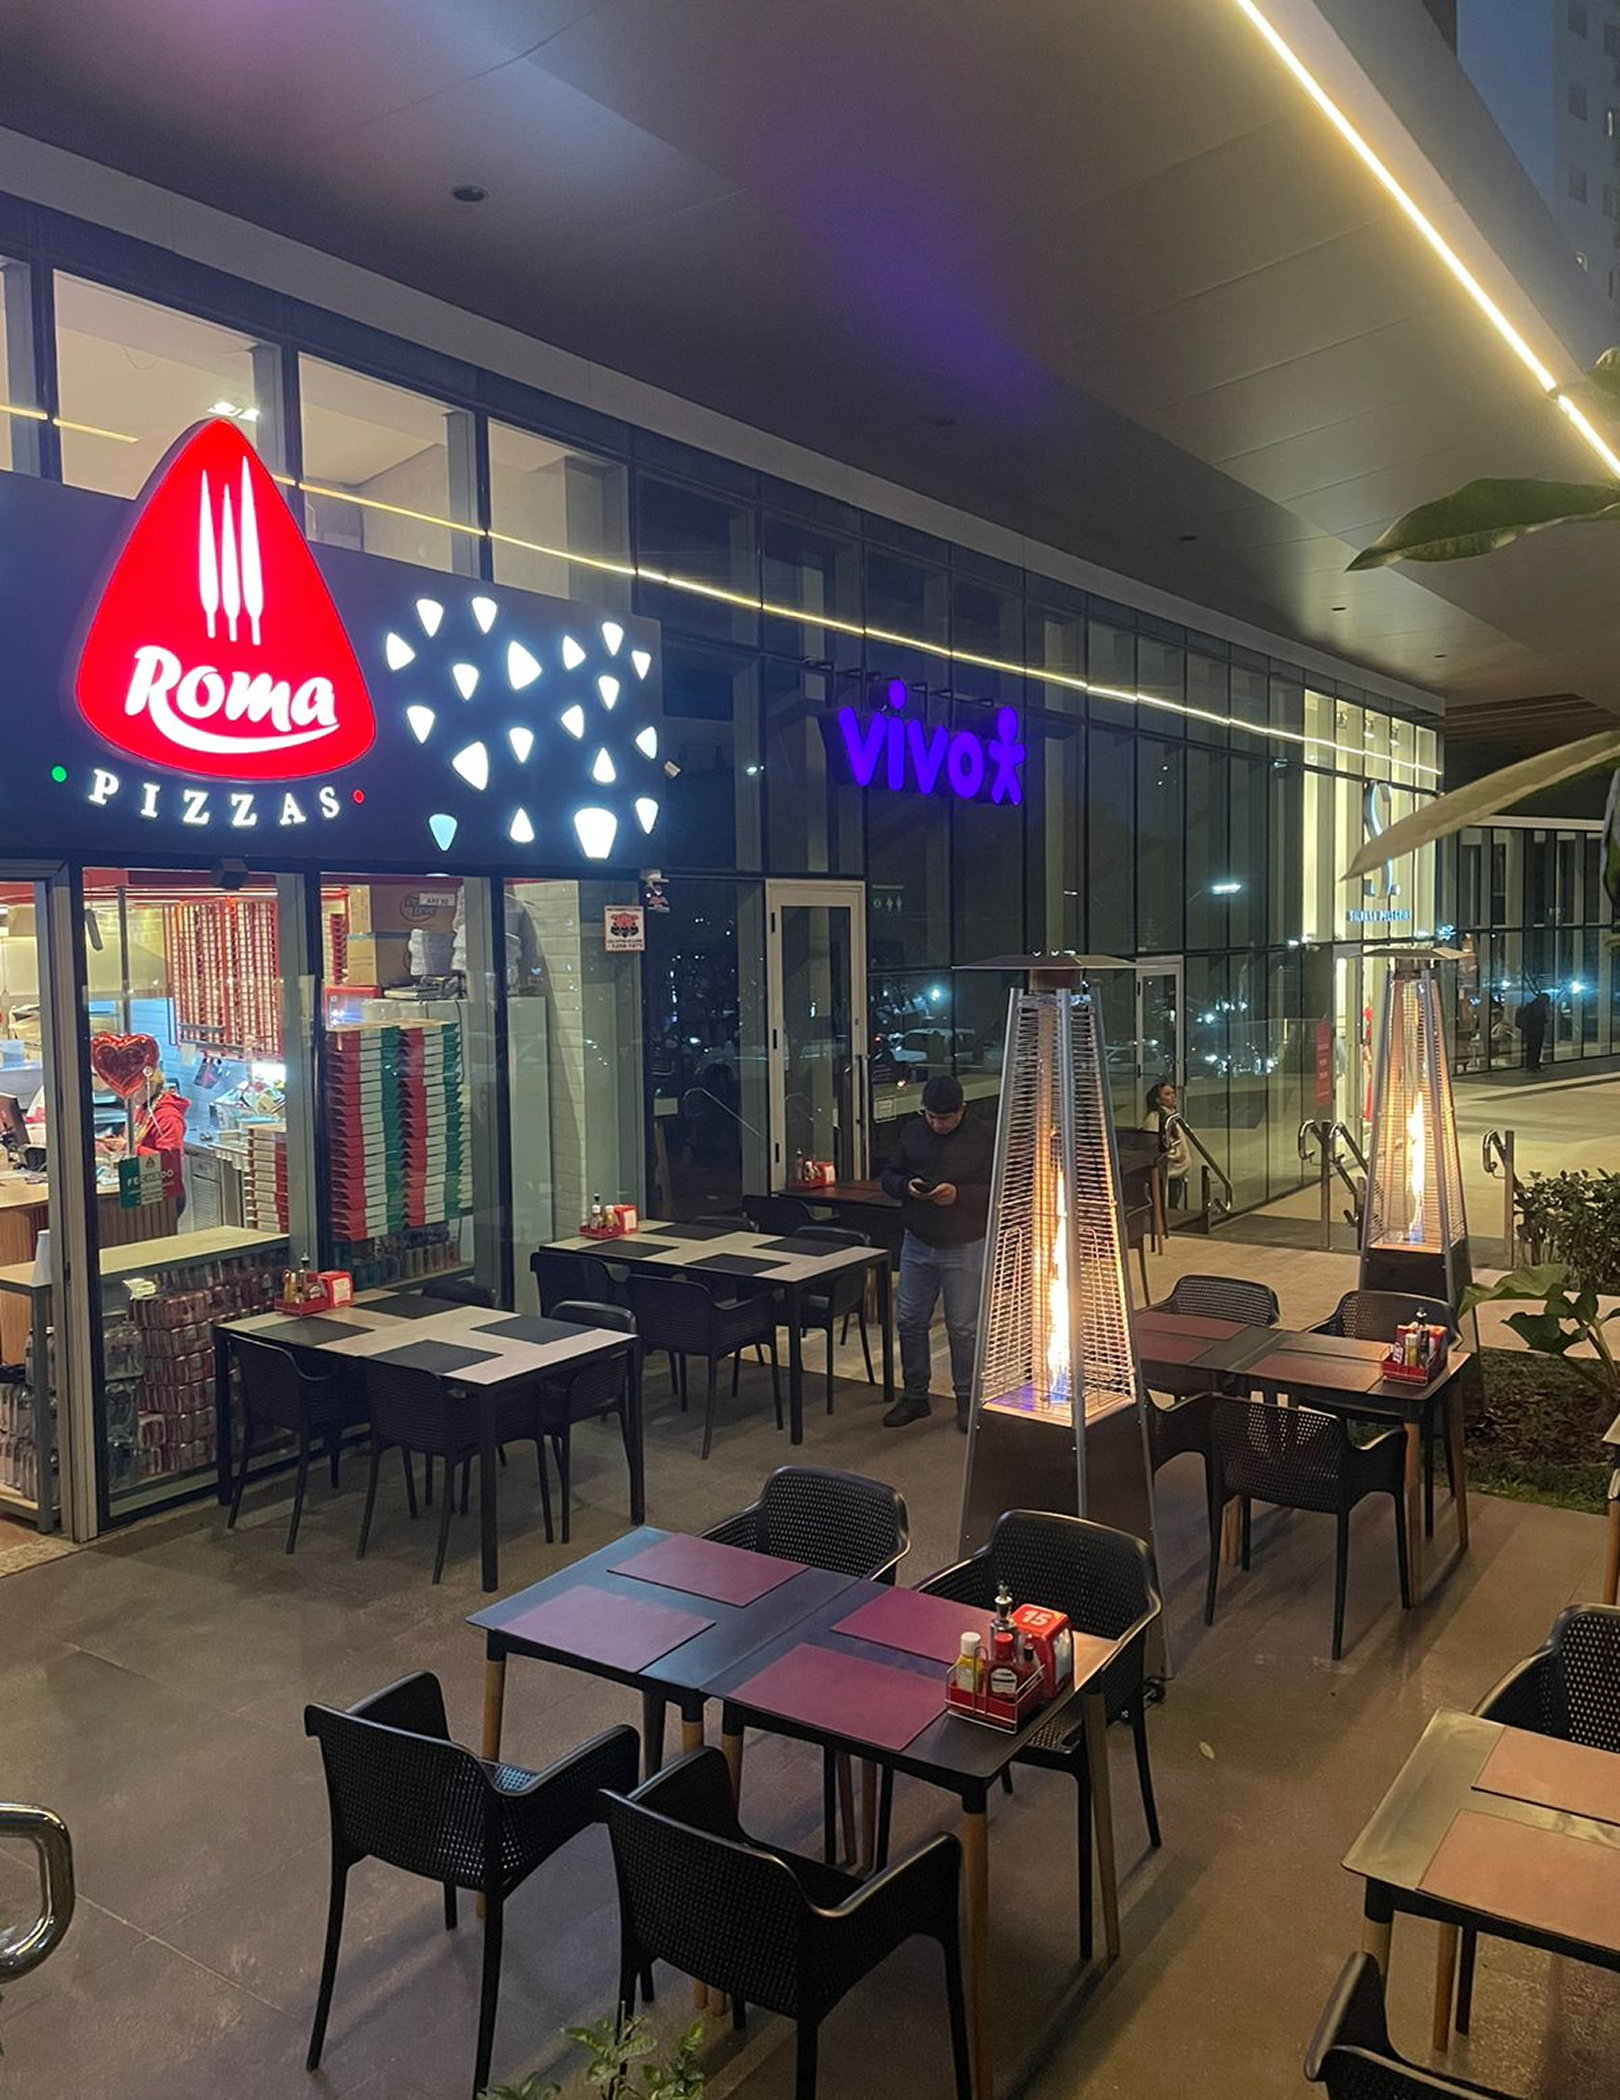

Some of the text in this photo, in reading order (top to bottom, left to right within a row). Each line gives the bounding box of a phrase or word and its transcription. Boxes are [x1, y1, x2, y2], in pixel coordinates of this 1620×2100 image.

[123, 645, 341, 755] Roma
[87, 768, 341, 828] PIZZAS
[1021, 1610, 1050, 1627] 15
